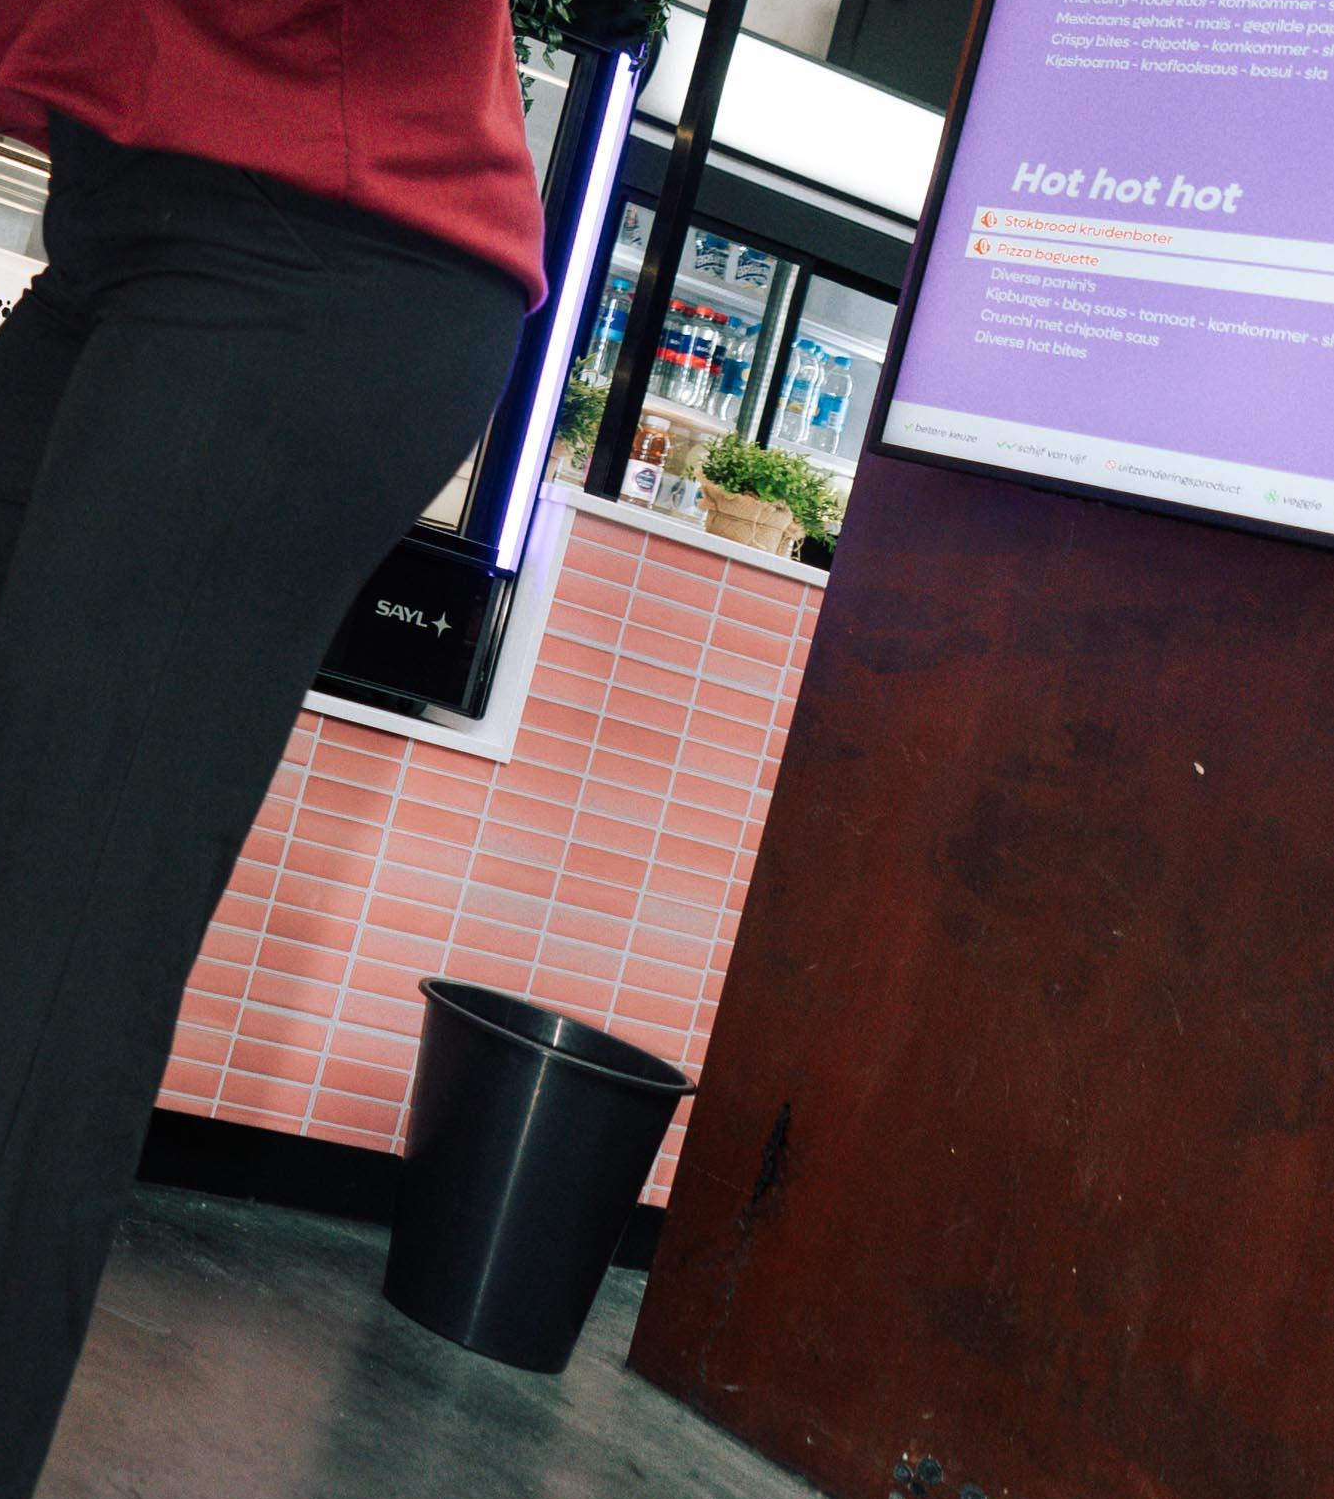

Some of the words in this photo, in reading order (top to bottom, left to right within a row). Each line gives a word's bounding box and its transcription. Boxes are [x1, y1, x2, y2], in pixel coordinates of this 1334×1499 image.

[1056, 12, 1131, 26] Mexicaans
[1132, 14, 1185, 29] gehakt
[1242, 19, 1305, 34] gegrilde
[1051, 33, 1094, 49] Crispy
[1095, 34, 1130, 48] bites
[1140, 36, 1200, 52] chipotle
[1211, 39, 1310, 57] komkommer
[1045, 54, 1130, 70] Kipshoarma
[1140, 58, 1238, 76] knoflooksaus
[1249, 61, 1293, 78] bosui
[1303, 66, 1328, 80] sla
[1010, 161, 1085, 199] Hot
[1088, 167, 1162, 205] hot
[1165, 174, 1244, 214] hot
[1004, 215, 1077, 234] Stokbrood
[1079, 223, 1173, 244] kruidenboter
[997, 243, 1033, 258] Pizza
[1034, 248, 1099, 266] baguette
[990, 267, 1041, 285] Diverse
[980, 308, 1033, 328] Crunchi
[1034, 317, 1063, 333] met
[1064, 321, 1123, 342] chipotle
[1124, 329, 1161, 347] saus
[985, 287, 1053, 308] Kipburger
[1061, 297, 1092, 317] bbq
[1093, 304, 1128, 319] saus
[1139, 308, 1197, 329] tomaat
[1208, 316, 1310, 345] komkommer
[974, 330, 1025, 349] Diverse
[1026, 337, 1051, 353] hot
[1052, 341, 1088, 359] bites
[375, 599, 428, 628] SAYL
